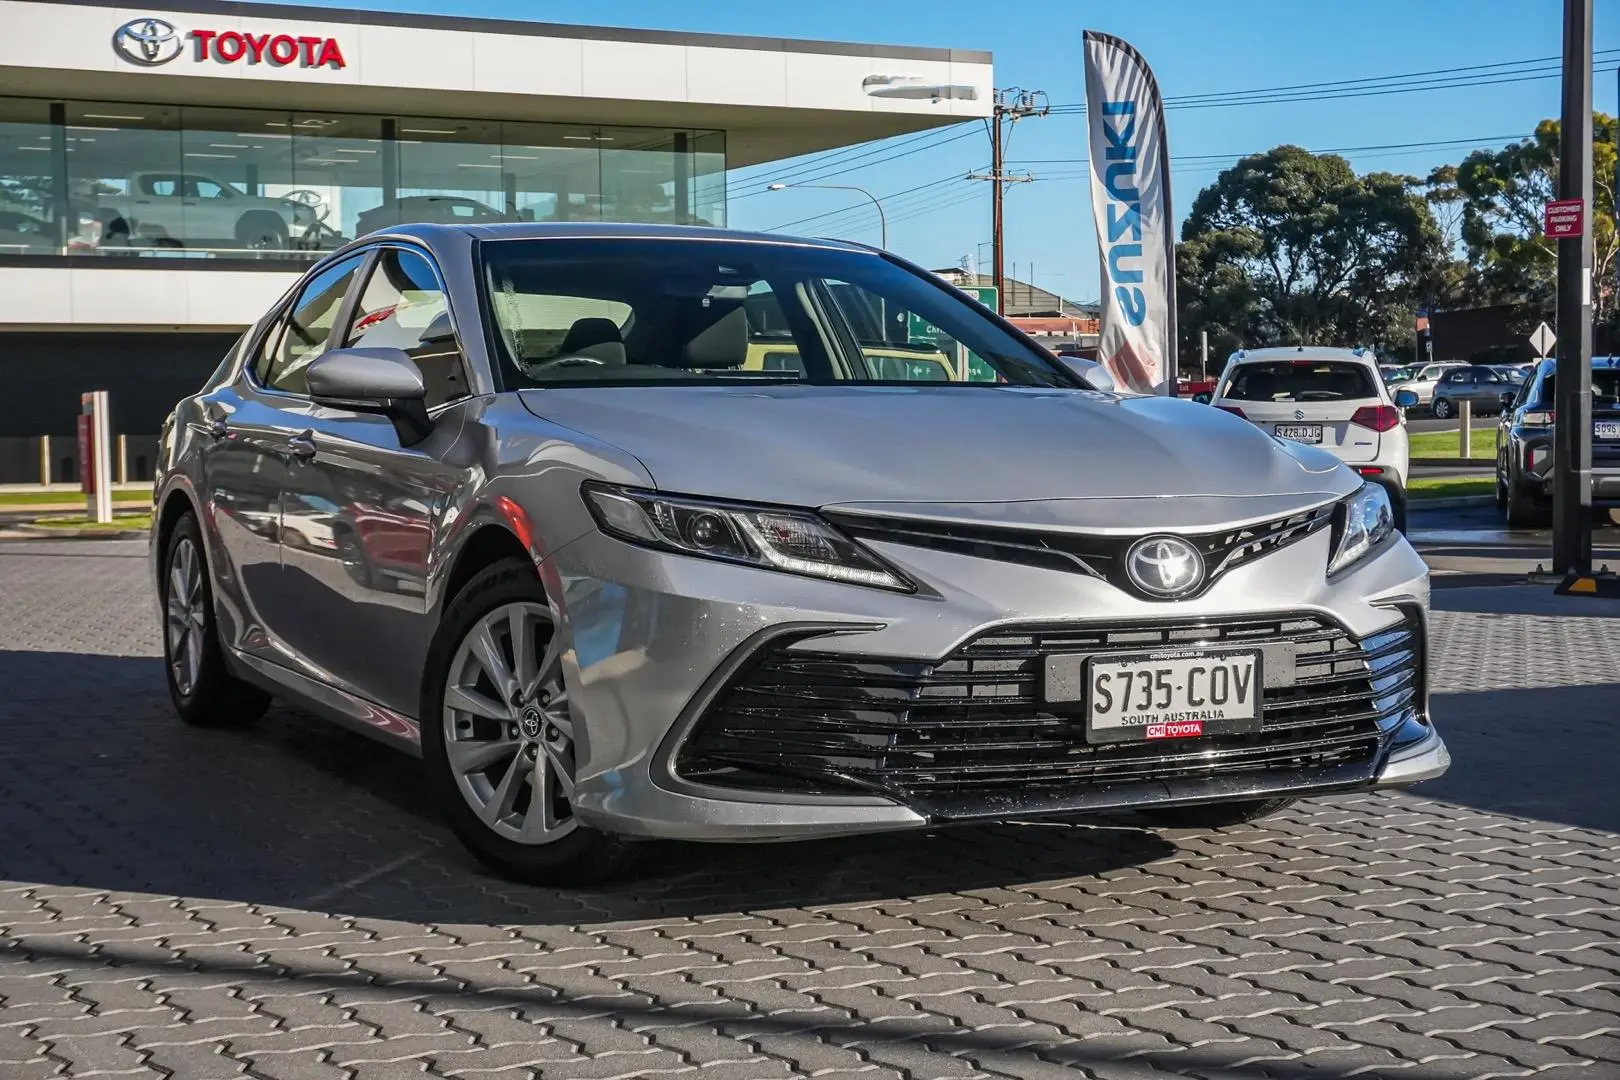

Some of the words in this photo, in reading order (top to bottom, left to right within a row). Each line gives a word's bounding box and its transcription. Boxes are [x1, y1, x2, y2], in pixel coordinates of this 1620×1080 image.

[192, 29, 346, 68] TOYOTA
[1547, 205, 1581, 214] CUSTOMER
[1550, 214, 1578, 223] PARKING
[1555, 224, 1572, 232] ONLY
[1149, 651, 1205, 660] cmitoyota.com.au
[1121, 715, 1159, 726] SOUTH
[1162, 710, 1225, 722] AUSTRALIA
[1167, 723, 1202, 735] TOYOTA
